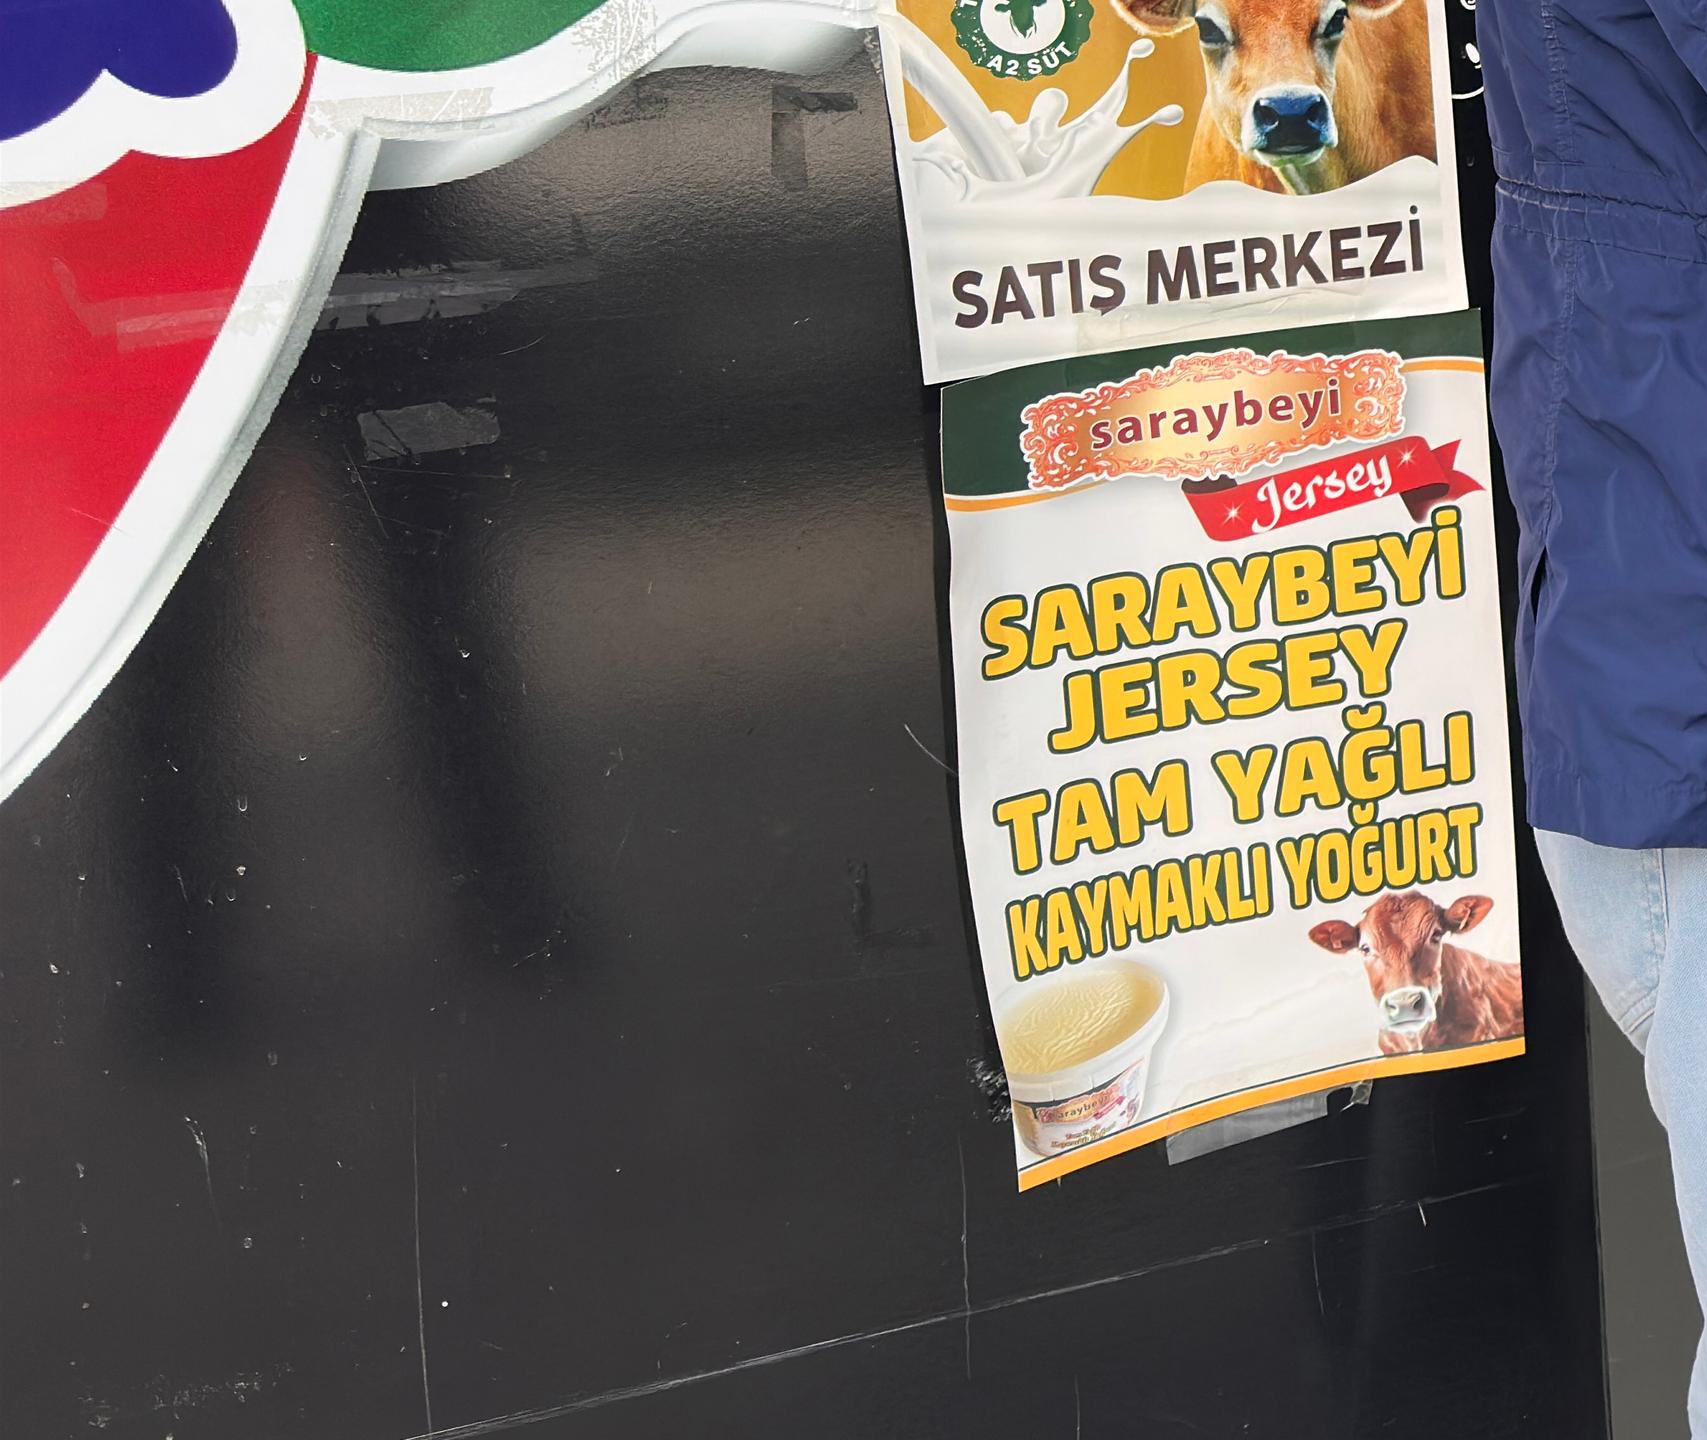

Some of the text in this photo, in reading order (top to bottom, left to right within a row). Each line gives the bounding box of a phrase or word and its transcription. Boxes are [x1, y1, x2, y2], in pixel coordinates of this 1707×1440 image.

[987, 41, 1072, 75] A2 SÜT
[953, 204, 1425, 329] SATIŞ MERKEZİ
[1090, 378, 1342, 451] saraybeyi
[1250, 454, 1395, 533] Jersey
[980, 505, 1465, 682] SARAYBEYİ
[1048, 620, 1406, 755] JERSEY
[994, 700, 1478, 877] TAM YAĞLI
[1005, 803, 1482, 984] KAYMAKLI YOĞURT
